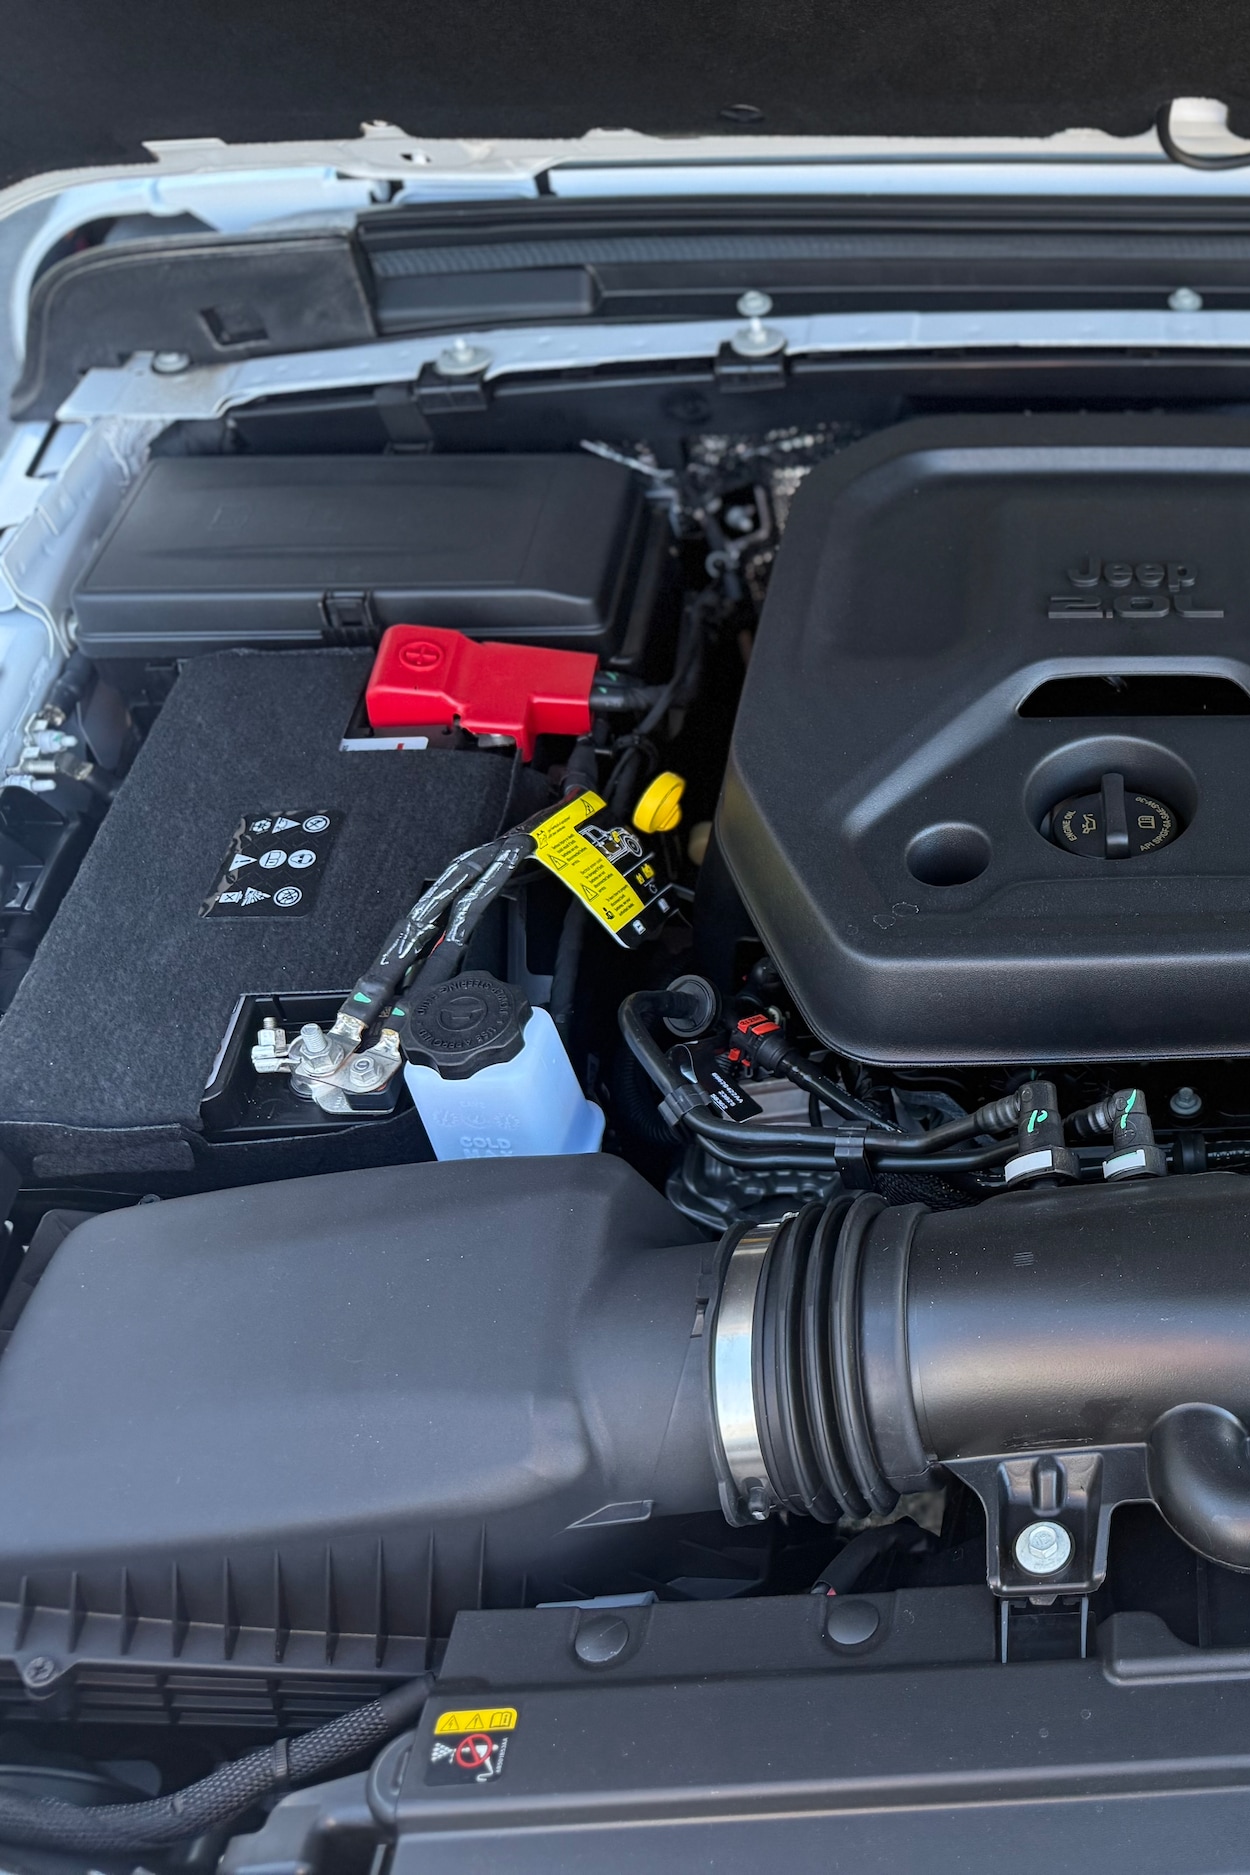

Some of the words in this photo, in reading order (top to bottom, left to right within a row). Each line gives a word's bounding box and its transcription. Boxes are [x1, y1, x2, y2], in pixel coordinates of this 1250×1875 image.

[1067, 557, 1198, 592] Jeep
[1048, 595, 1224, 619] 2.0L
[1063, 809, 1077, 820] OIL
[1062, 819, 1078, 842] ENGINE
[1139, 841, 1156, 852] API
[459, 1136, 512, 1149] COLD
